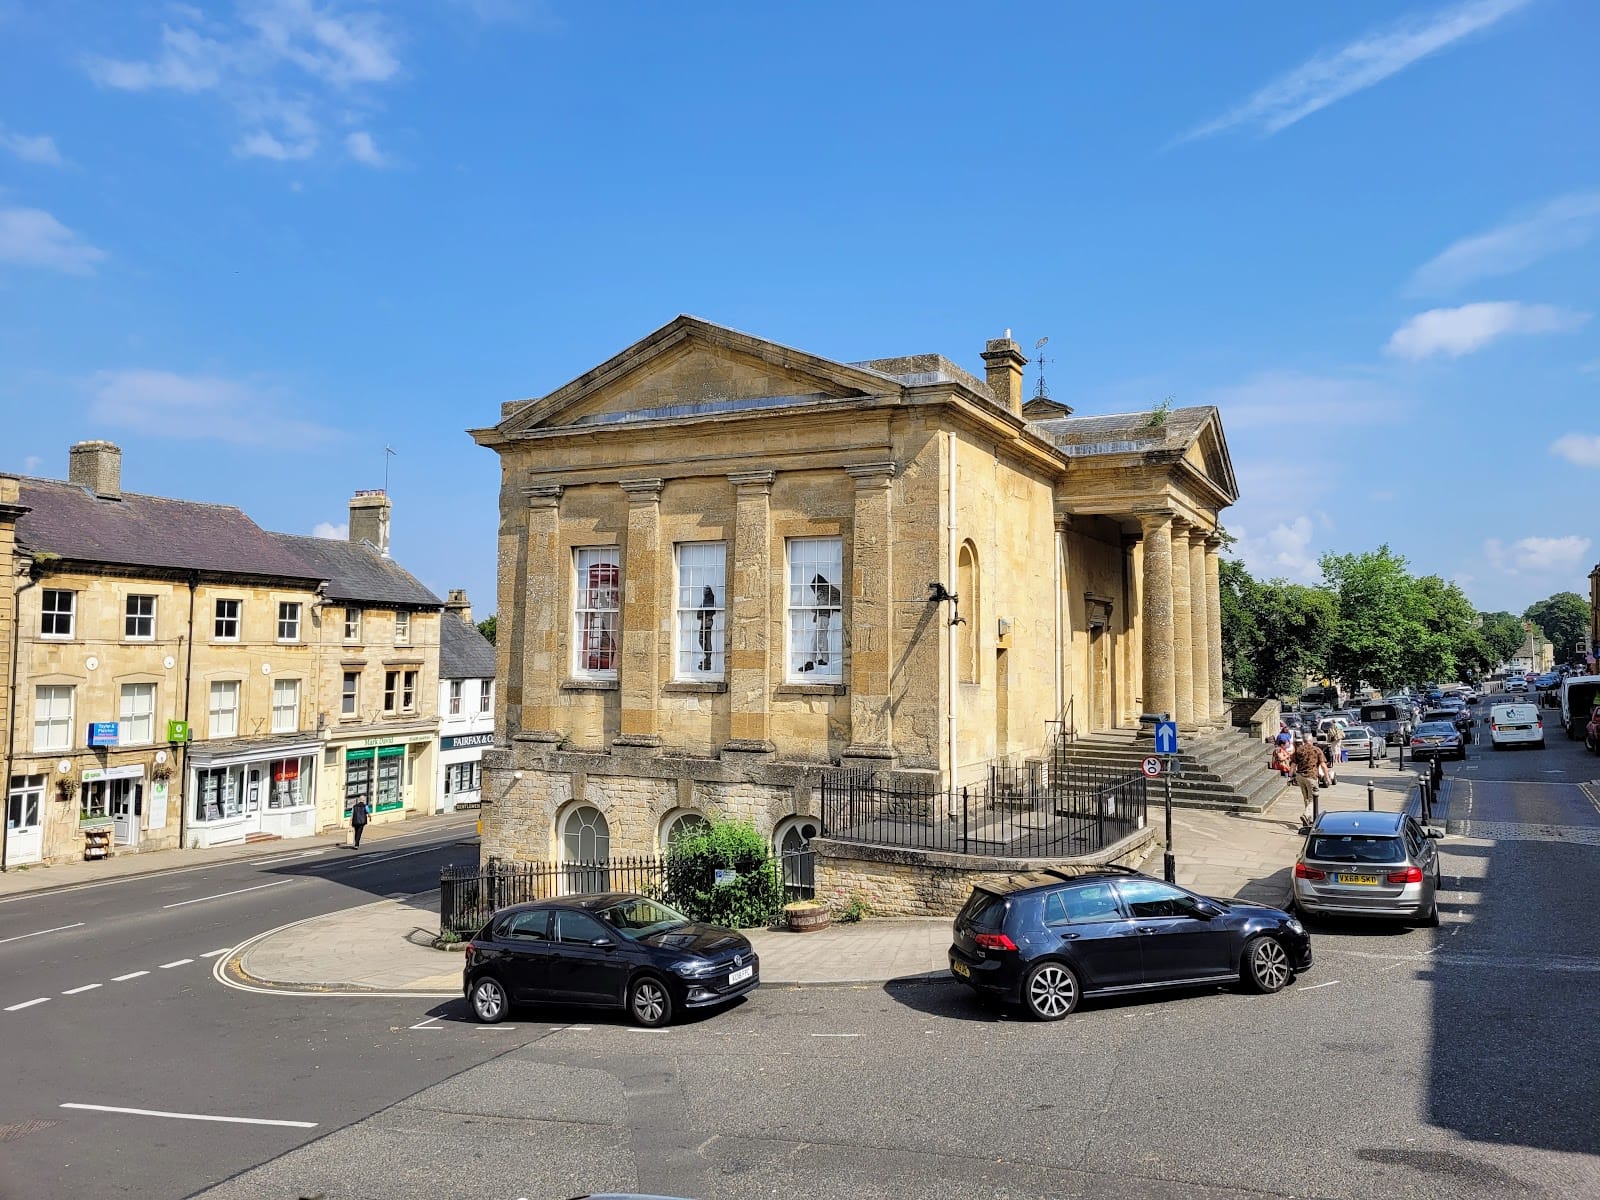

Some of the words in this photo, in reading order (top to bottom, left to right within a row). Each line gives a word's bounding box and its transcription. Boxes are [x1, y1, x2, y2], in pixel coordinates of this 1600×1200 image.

[364, 737, 378, 746] Mark
[453, 735, 481, 747] FAIRFAX
[481, 735, 487, 743] &
[1147, 759, 1157, 774] 20
